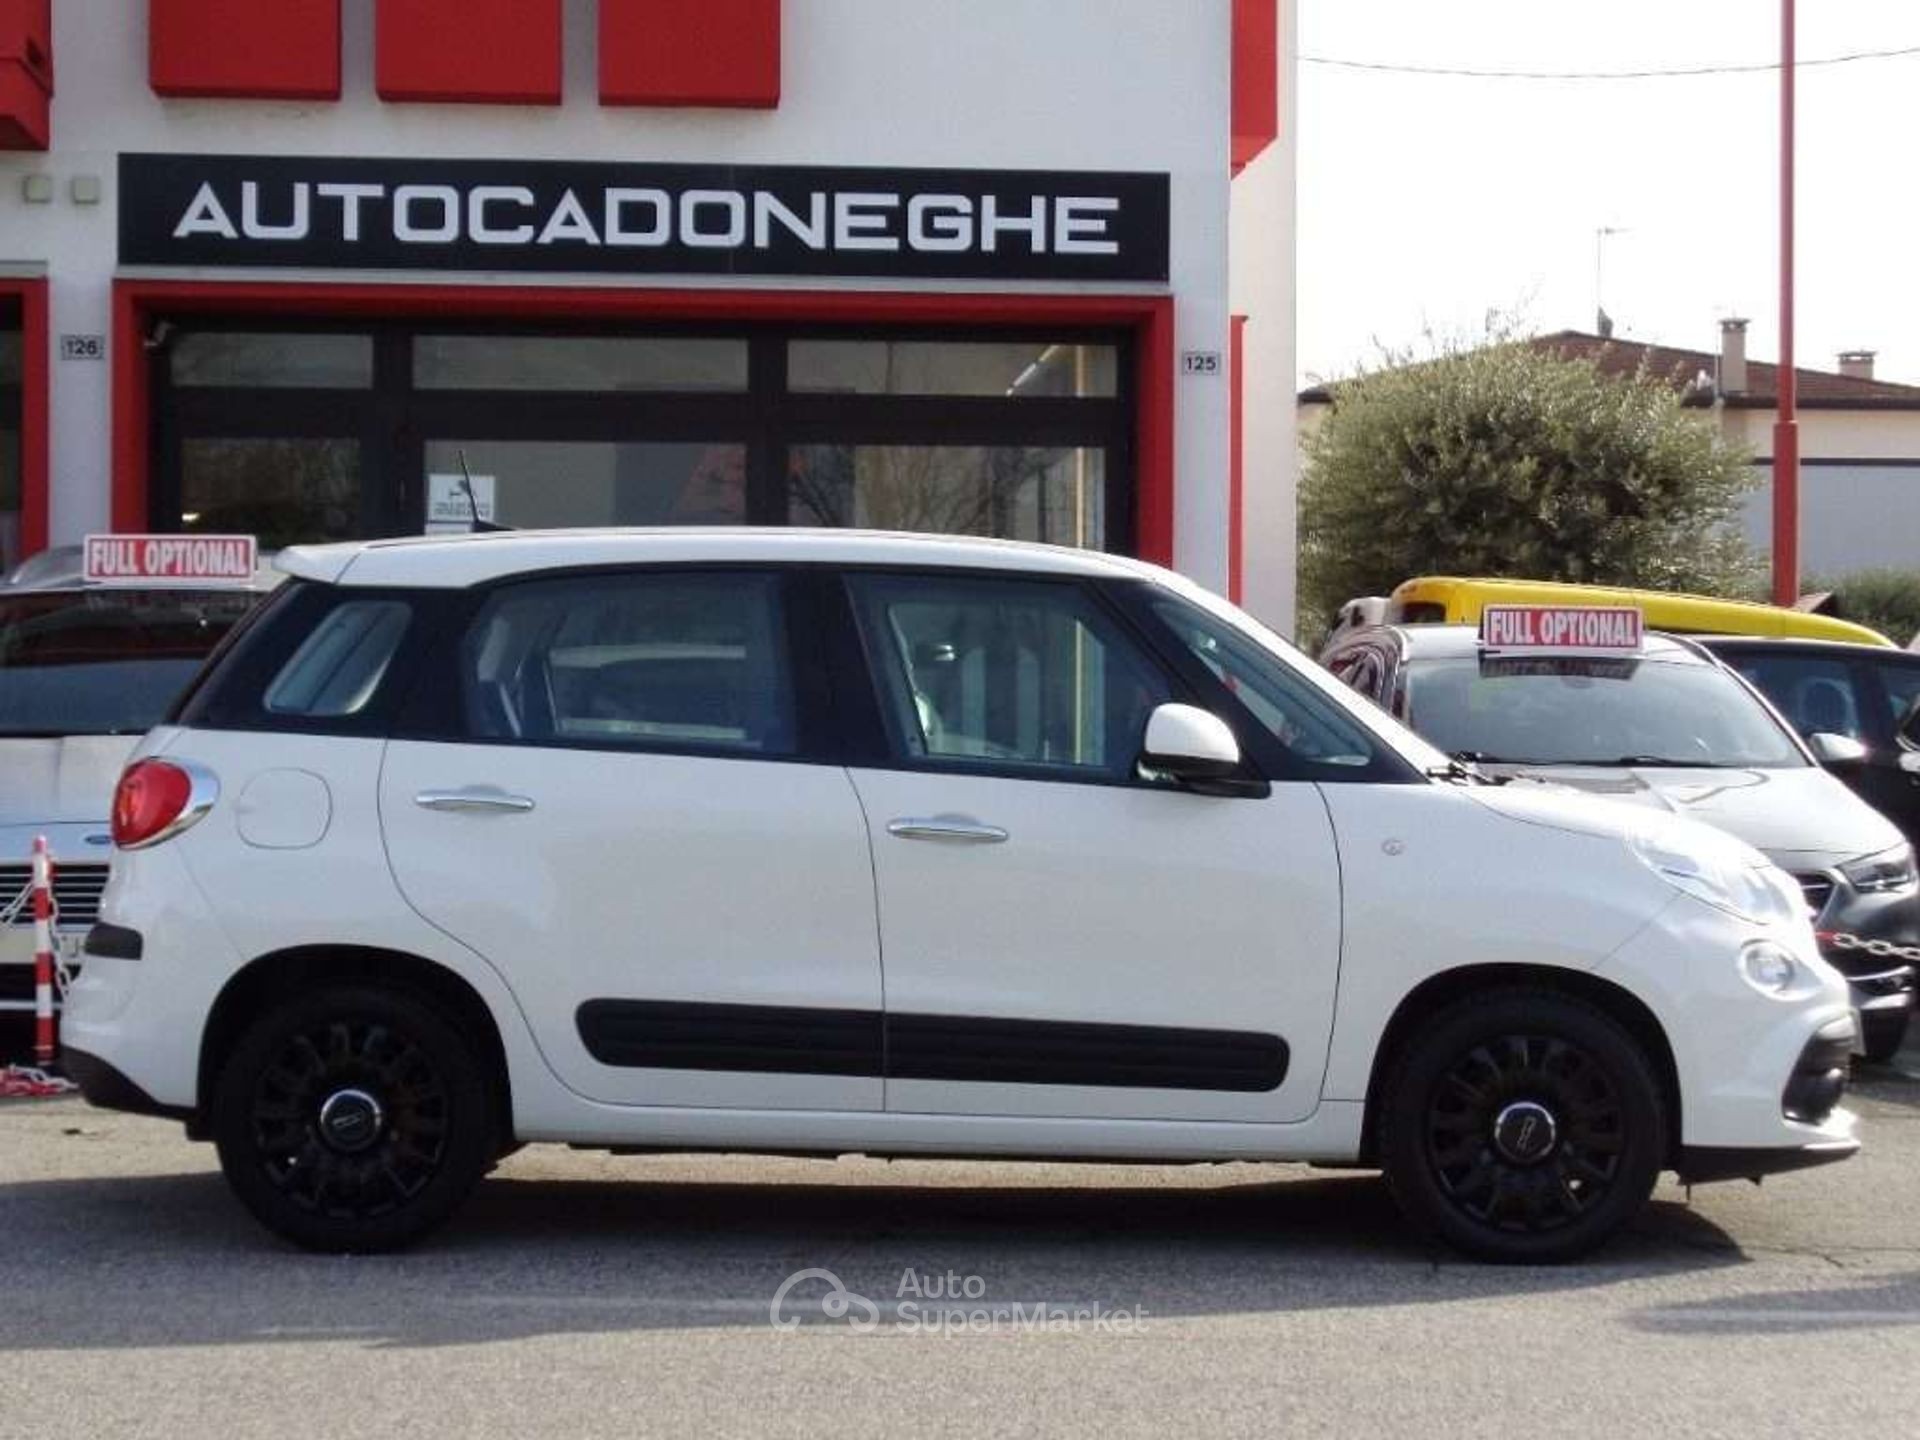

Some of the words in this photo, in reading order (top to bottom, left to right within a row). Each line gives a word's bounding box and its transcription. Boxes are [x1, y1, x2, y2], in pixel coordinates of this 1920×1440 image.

[173, 180, 1120, 256] AUTOCADONEGHE
[66, 340, 98, 355] 126
[1187, 356, 1217, 371] 125
[90, 540, 139, 575] FULL
[144, 540, 249, 575] OPTIONAL
[1489, 610, 1535, 644] FULL
[1539, 611, 1636, 645] OPTIONAL
